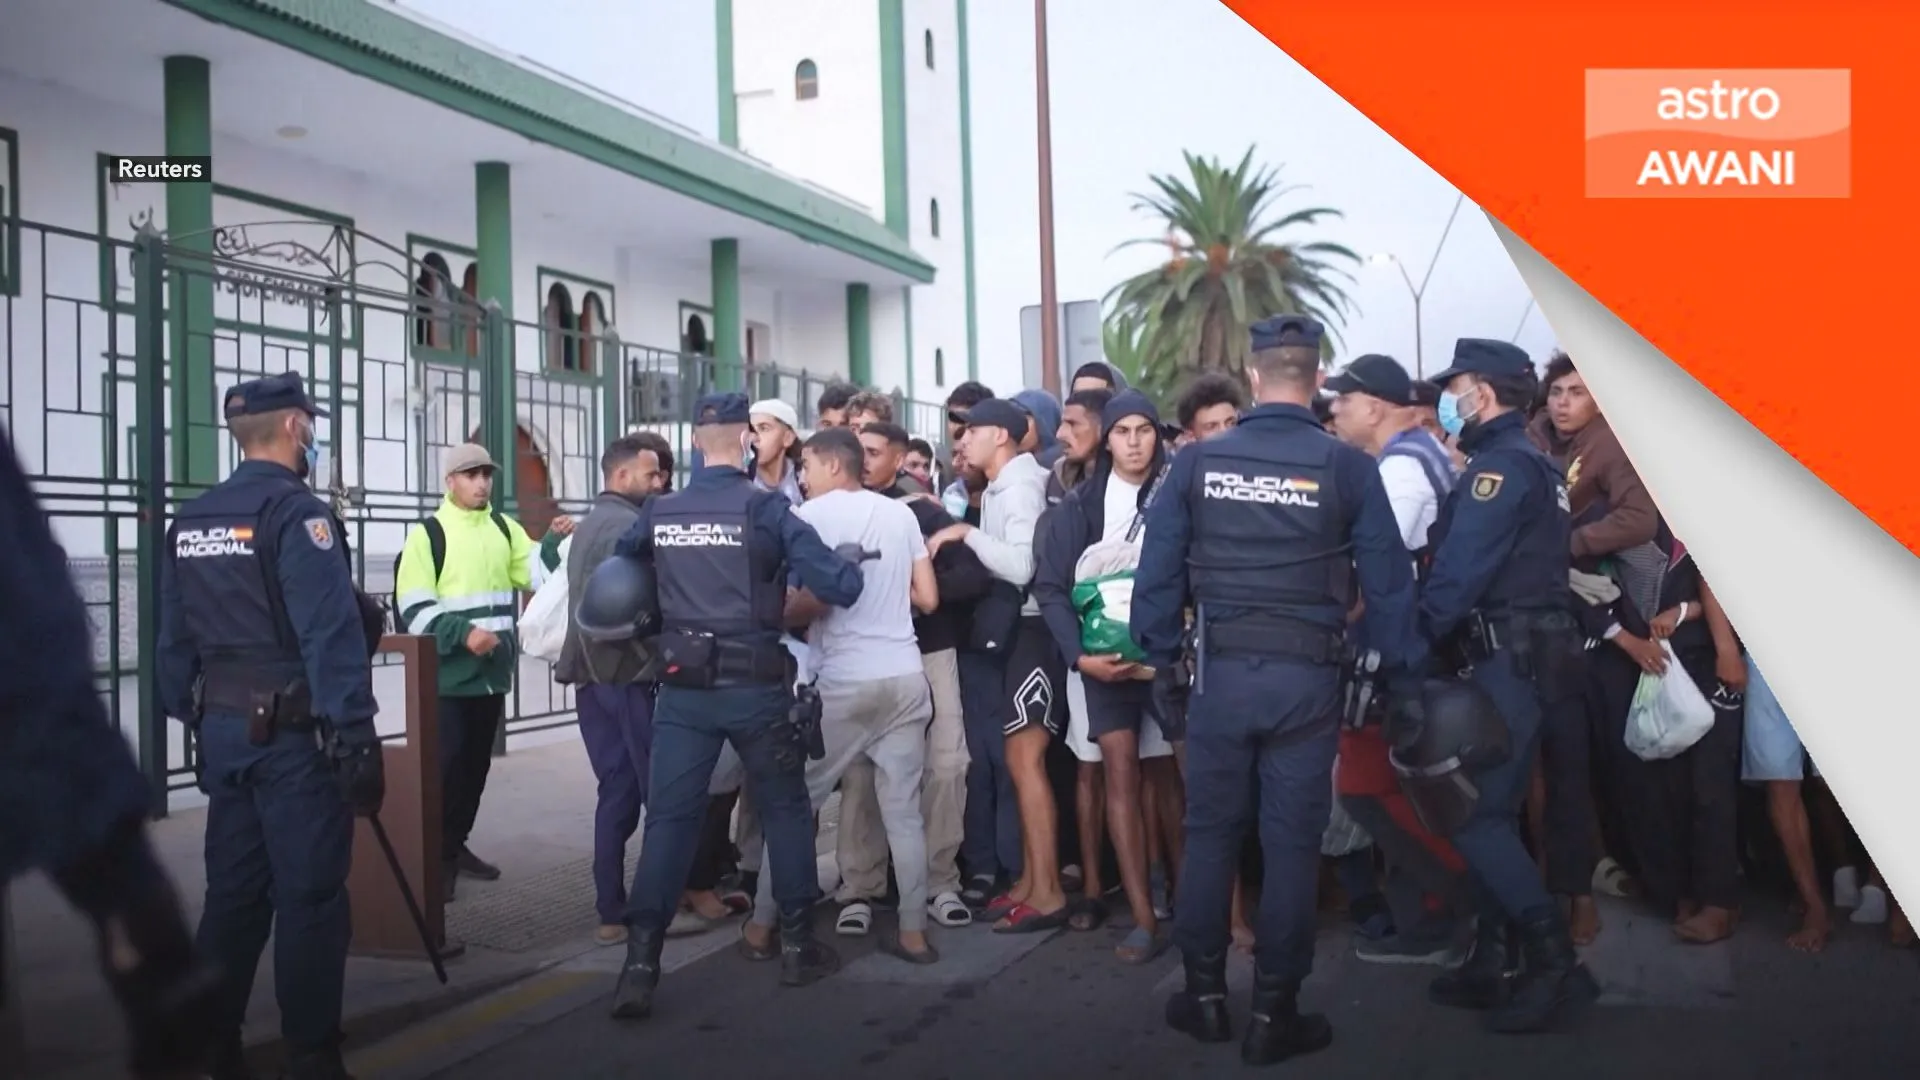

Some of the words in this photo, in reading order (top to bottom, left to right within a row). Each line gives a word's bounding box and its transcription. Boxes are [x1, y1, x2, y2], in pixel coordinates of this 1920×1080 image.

[1204, 471, 1296, 491] POLICIA
[1204, 485, 1320, 507] NACIONAL
[176, 527, 236, 545] POLICIA
[654, 523, 723, 535] POLICIA
[654, 534, 742, 546] NACIONAL
[176, 541, 254, 558] NACIONAL
